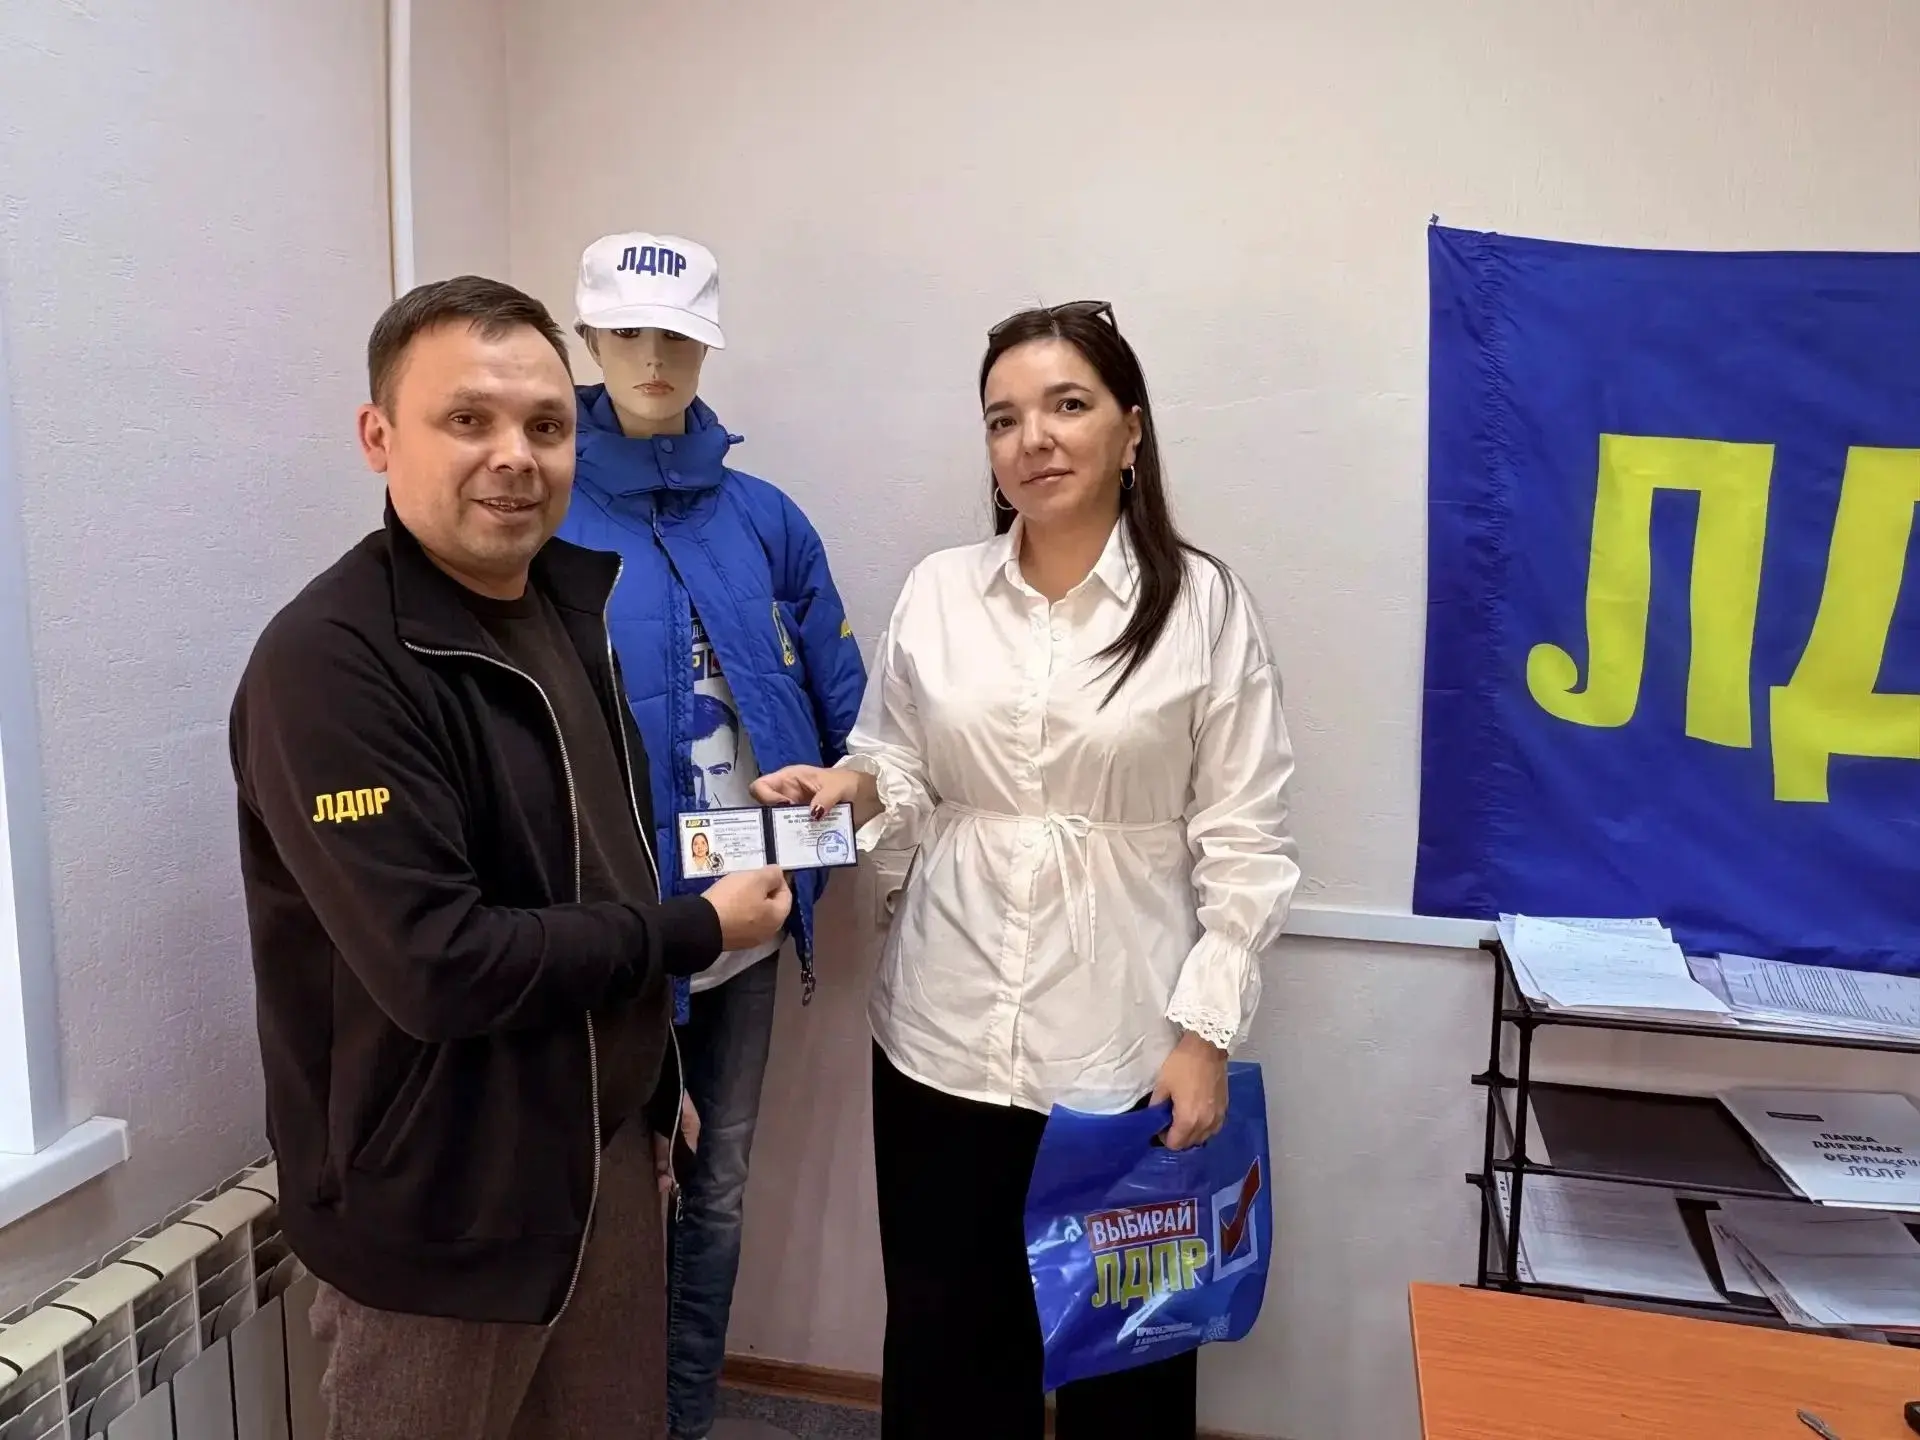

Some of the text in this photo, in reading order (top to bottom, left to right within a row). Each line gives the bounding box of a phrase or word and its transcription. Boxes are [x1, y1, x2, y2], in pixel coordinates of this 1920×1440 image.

[617, 246, 687, 277] ЛДПР
[312, 787, 390, 823] ЛДПР
[1820, 1133, 1879, 1143] ПАПКА
[1847, 1143, 1904, 1154] БУМАГ
[1843, 1165, 1906, 1179] ЛДПР
[1091, 1201, 1192, 1246] ВЫБИРАЙ
[1092, 1239, 1208, 1309] ЛДПР
